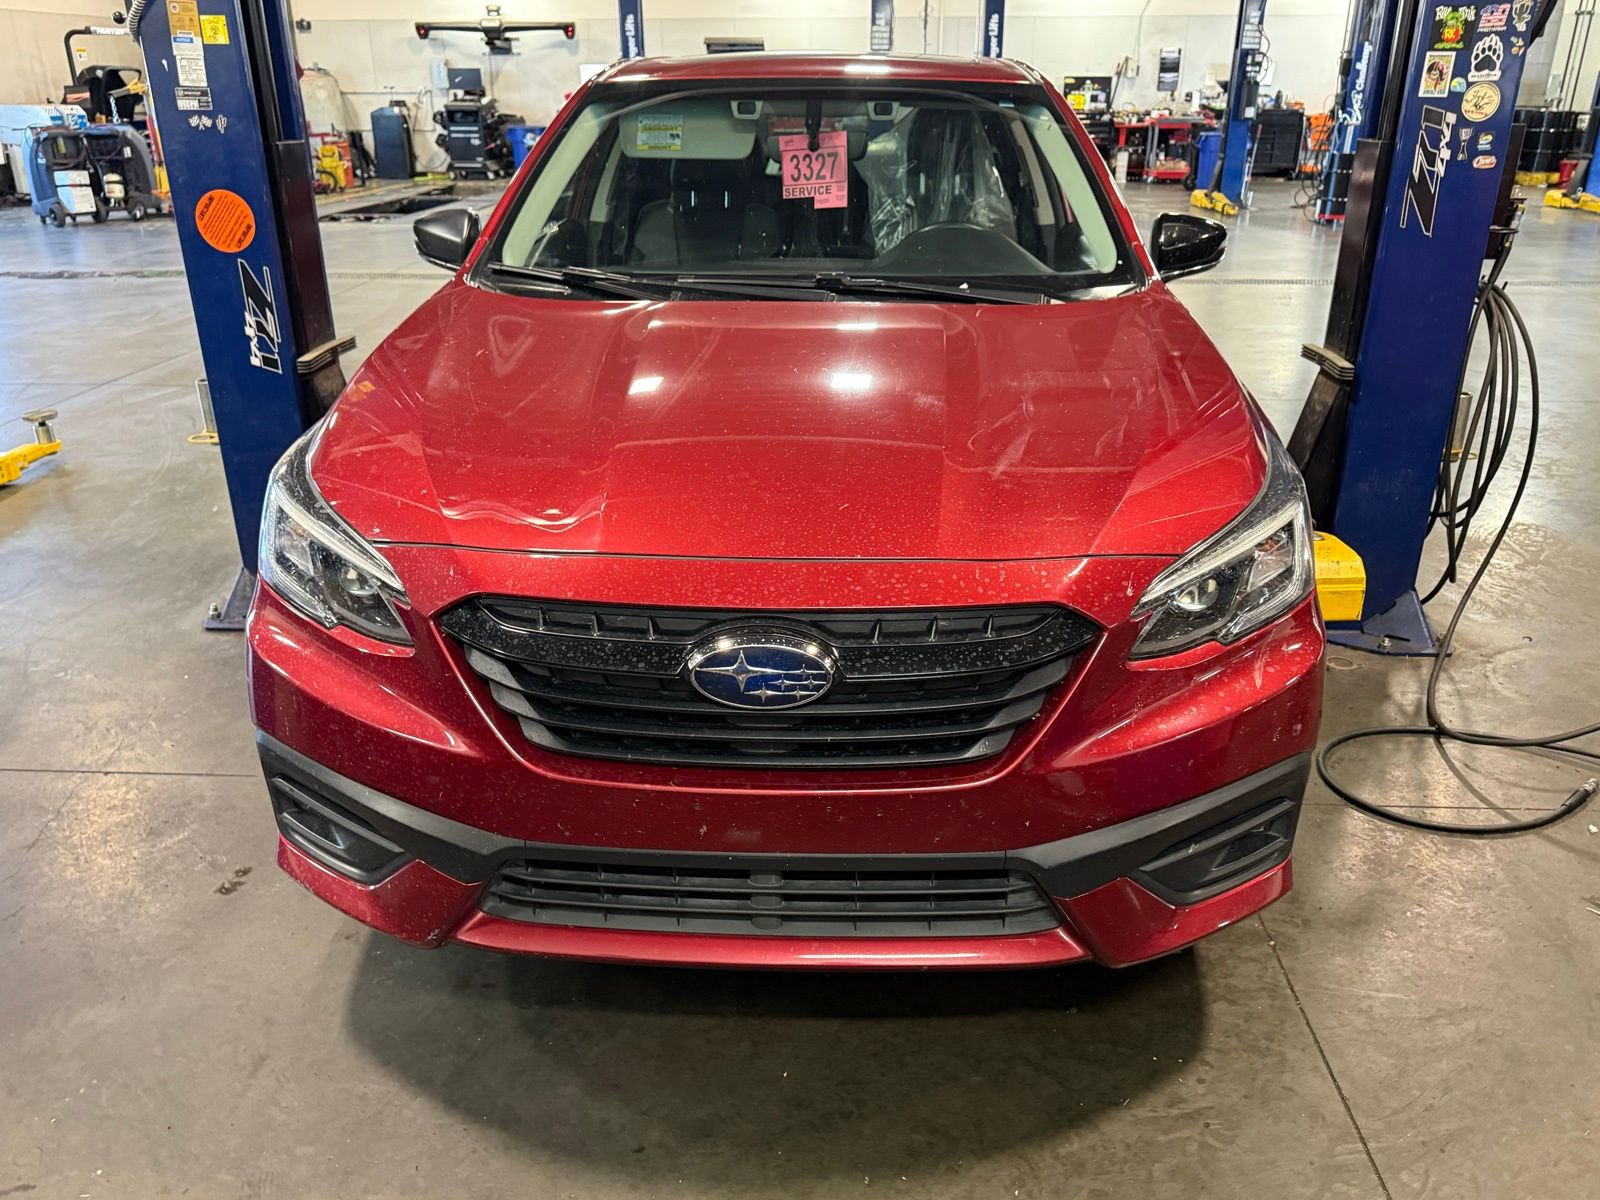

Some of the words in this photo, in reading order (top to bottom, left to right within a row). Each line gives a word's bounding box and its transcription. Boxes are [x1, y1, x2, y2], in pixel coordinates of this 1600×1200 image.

[988, 13, 1000, 37] Lifts
[790, 151, 838, 182] 3327
[1400, 105, 1446, 238] Z71
[784, 185, 832, 198] SERVICE
[237, 258, 283, 374] Z71
